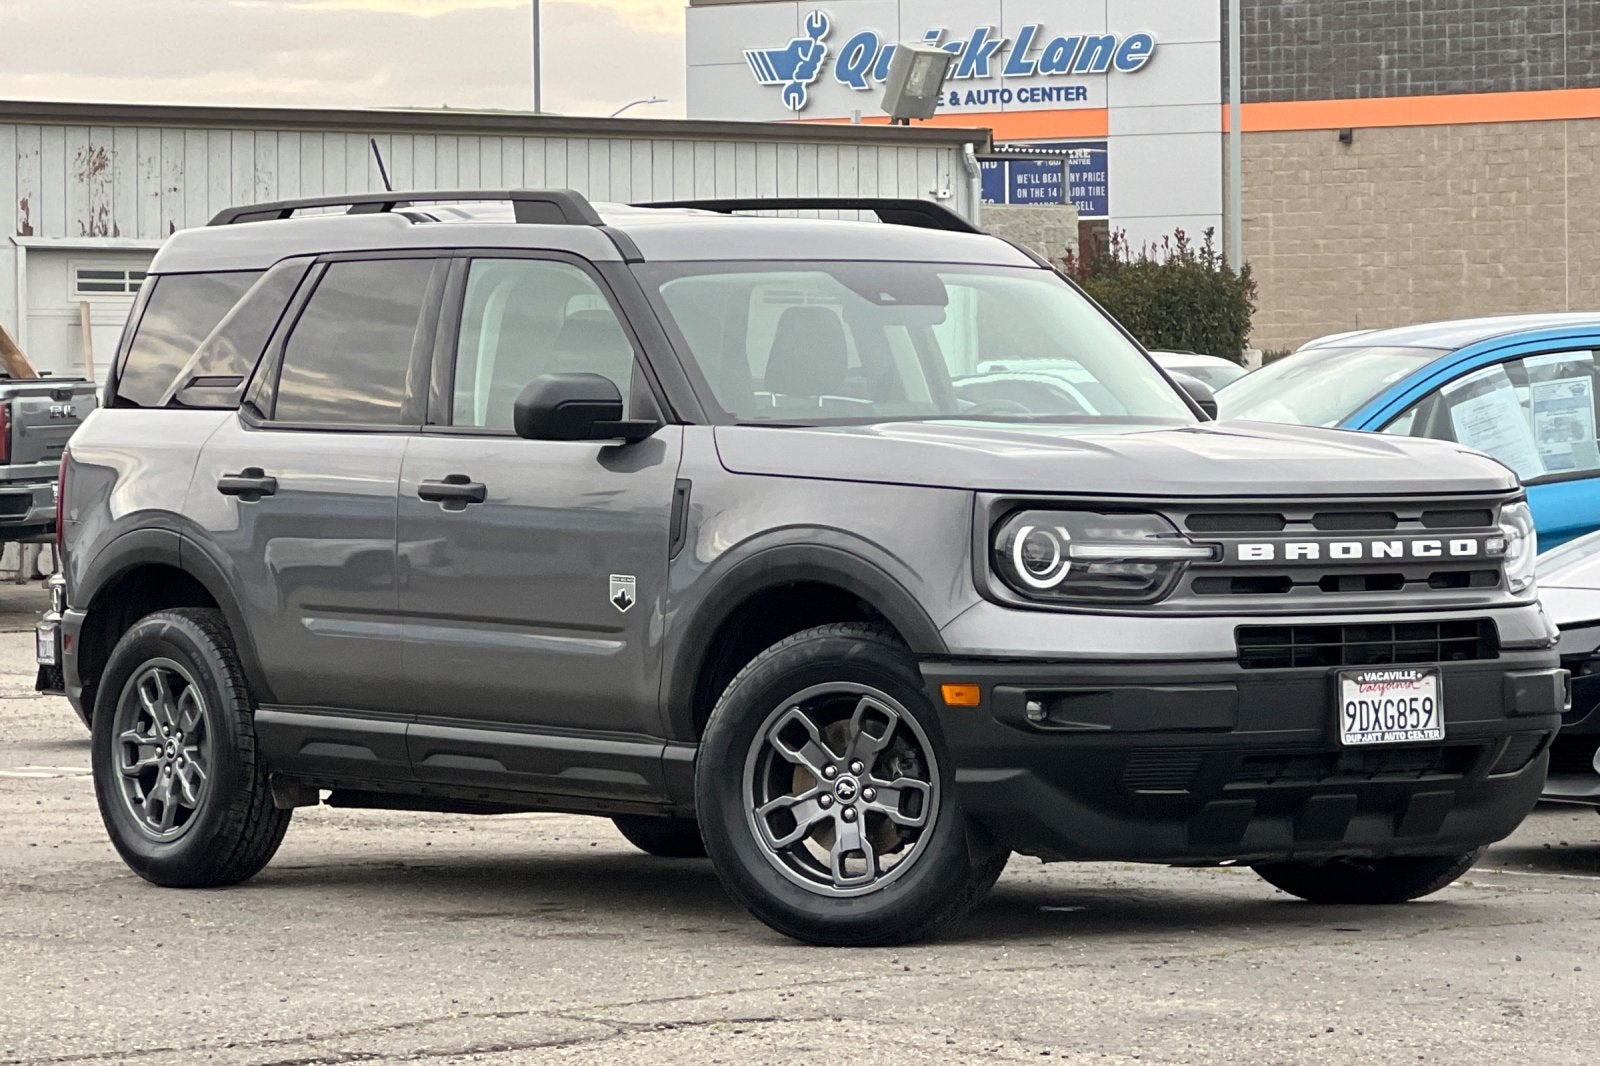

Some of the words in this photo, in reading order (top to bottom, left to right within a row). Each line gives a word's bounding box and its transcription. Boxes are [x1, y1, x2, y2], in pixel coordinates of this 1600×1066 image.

[834, 27, 1006, 90] Quk
[1002, 24, 1155, 77] Lane
[949, 91, 961, 106] &
[965, 88, 1012, 105] AUTO
[1016, 85, 1088, 103] CENTER
[1017, 174, 1040, 184] WE'LL
[1042, 172, 1061, 183] BEAT
[1082, 171, 1105, 183] PRICE
[1017, 188, 1027, 198] ON
[1030, 187, 1045, 198] THE
[1047, 187, 1058, 197] 14
[1060, 186, 1086, 198] JOR
[1088, 186, 1106, 197] TIRE
[1075, 200, 1095, 211] SELL
[1237, 539, 1478, 561] BRONCO
[1363, 671, 1416, 681] VACAVILLE
[1346, 697, 1433, 732] 9DXG859
[1384, 731, 1406, 742] AUTO
